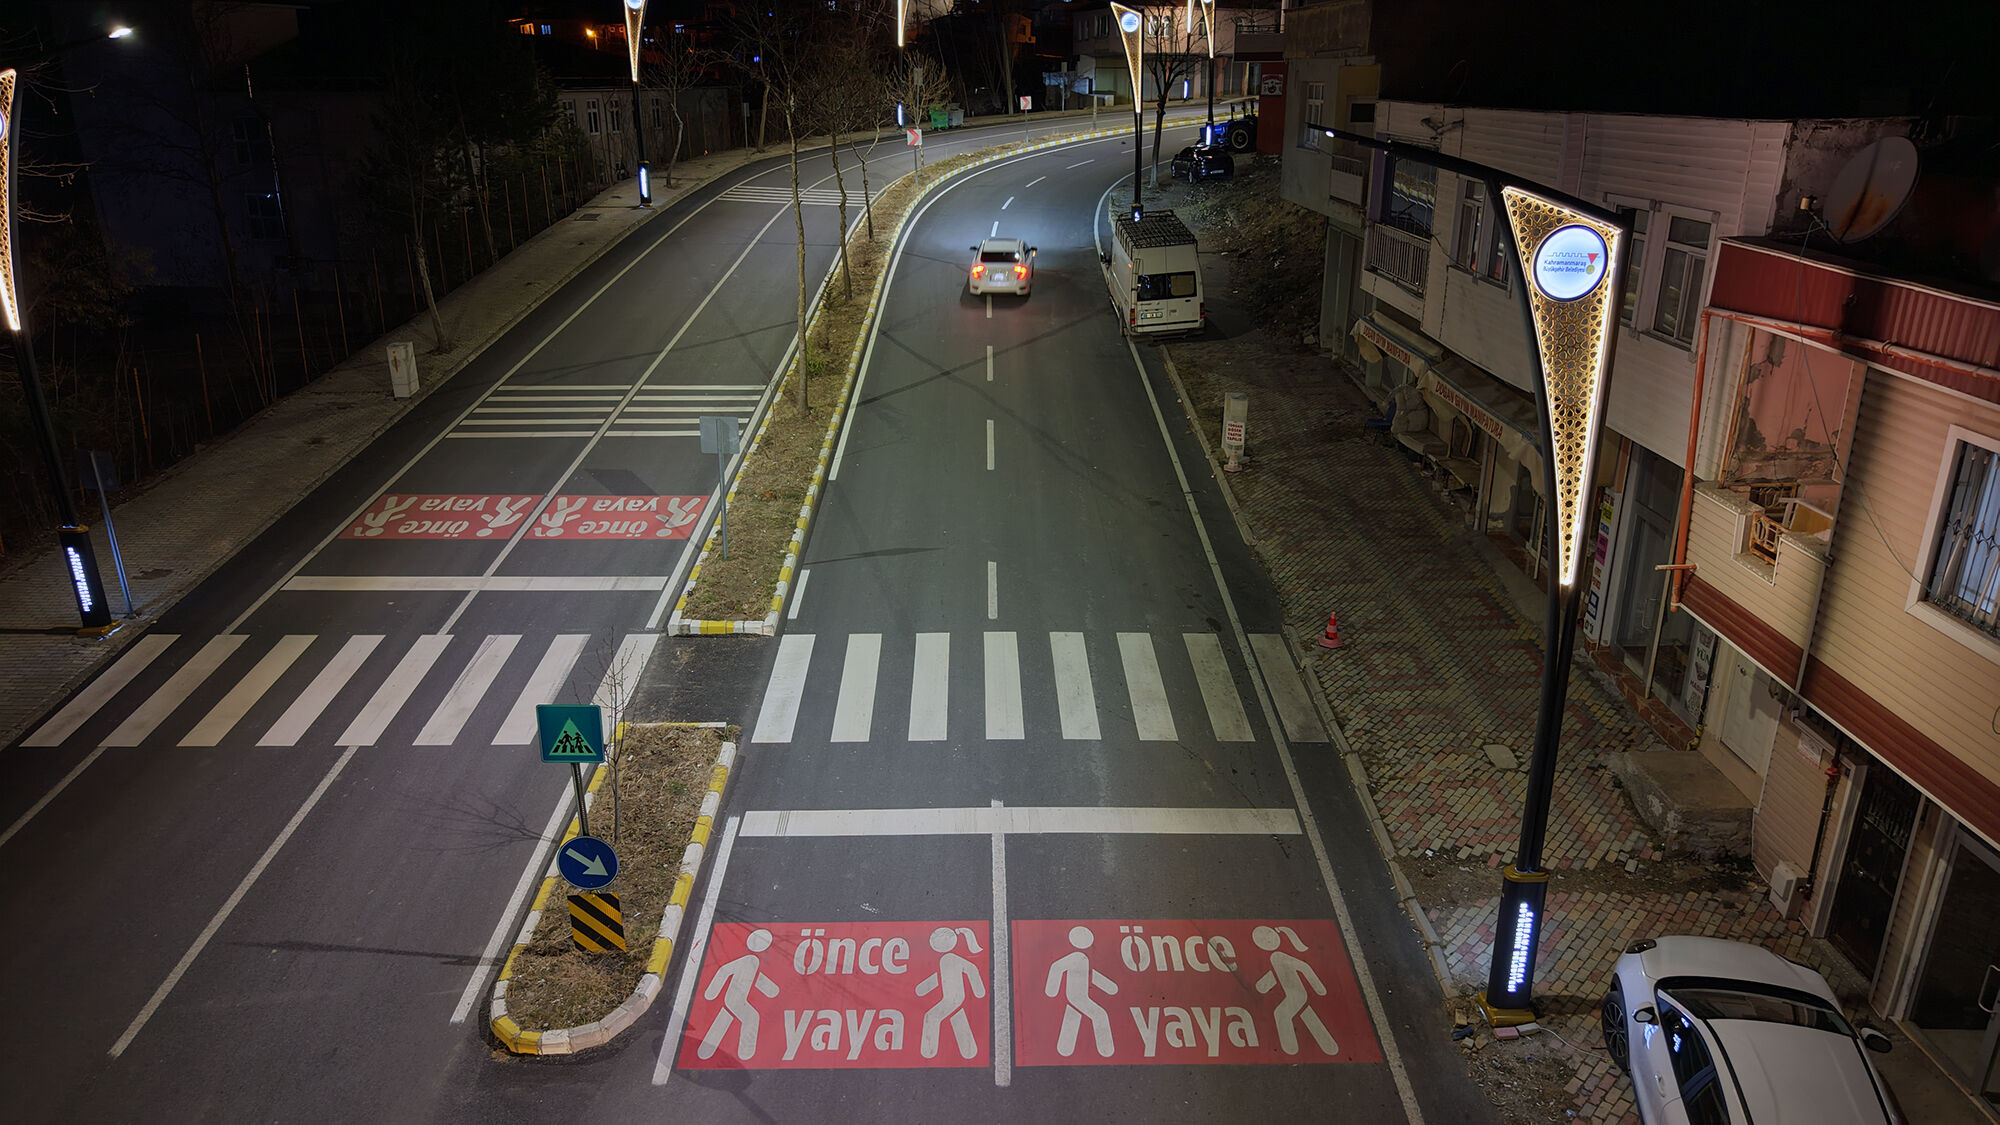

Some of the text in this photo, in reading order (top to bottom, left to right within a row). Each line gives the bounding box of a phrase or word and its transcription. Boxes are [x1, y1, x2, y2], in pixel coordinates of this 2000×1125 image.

[419, 498, 485, 512] yaya
[592, 498, 659, 513] yaya
[398, 519, 469, 538] önce
[578, 520, 648, 538] önce
[793, 929, 910, 976] önce
[1120, 926, 1237, 974] önce
[783, 1008, 905, 1061] yaya
[1129, 1006, 1260, 1058] yaya
